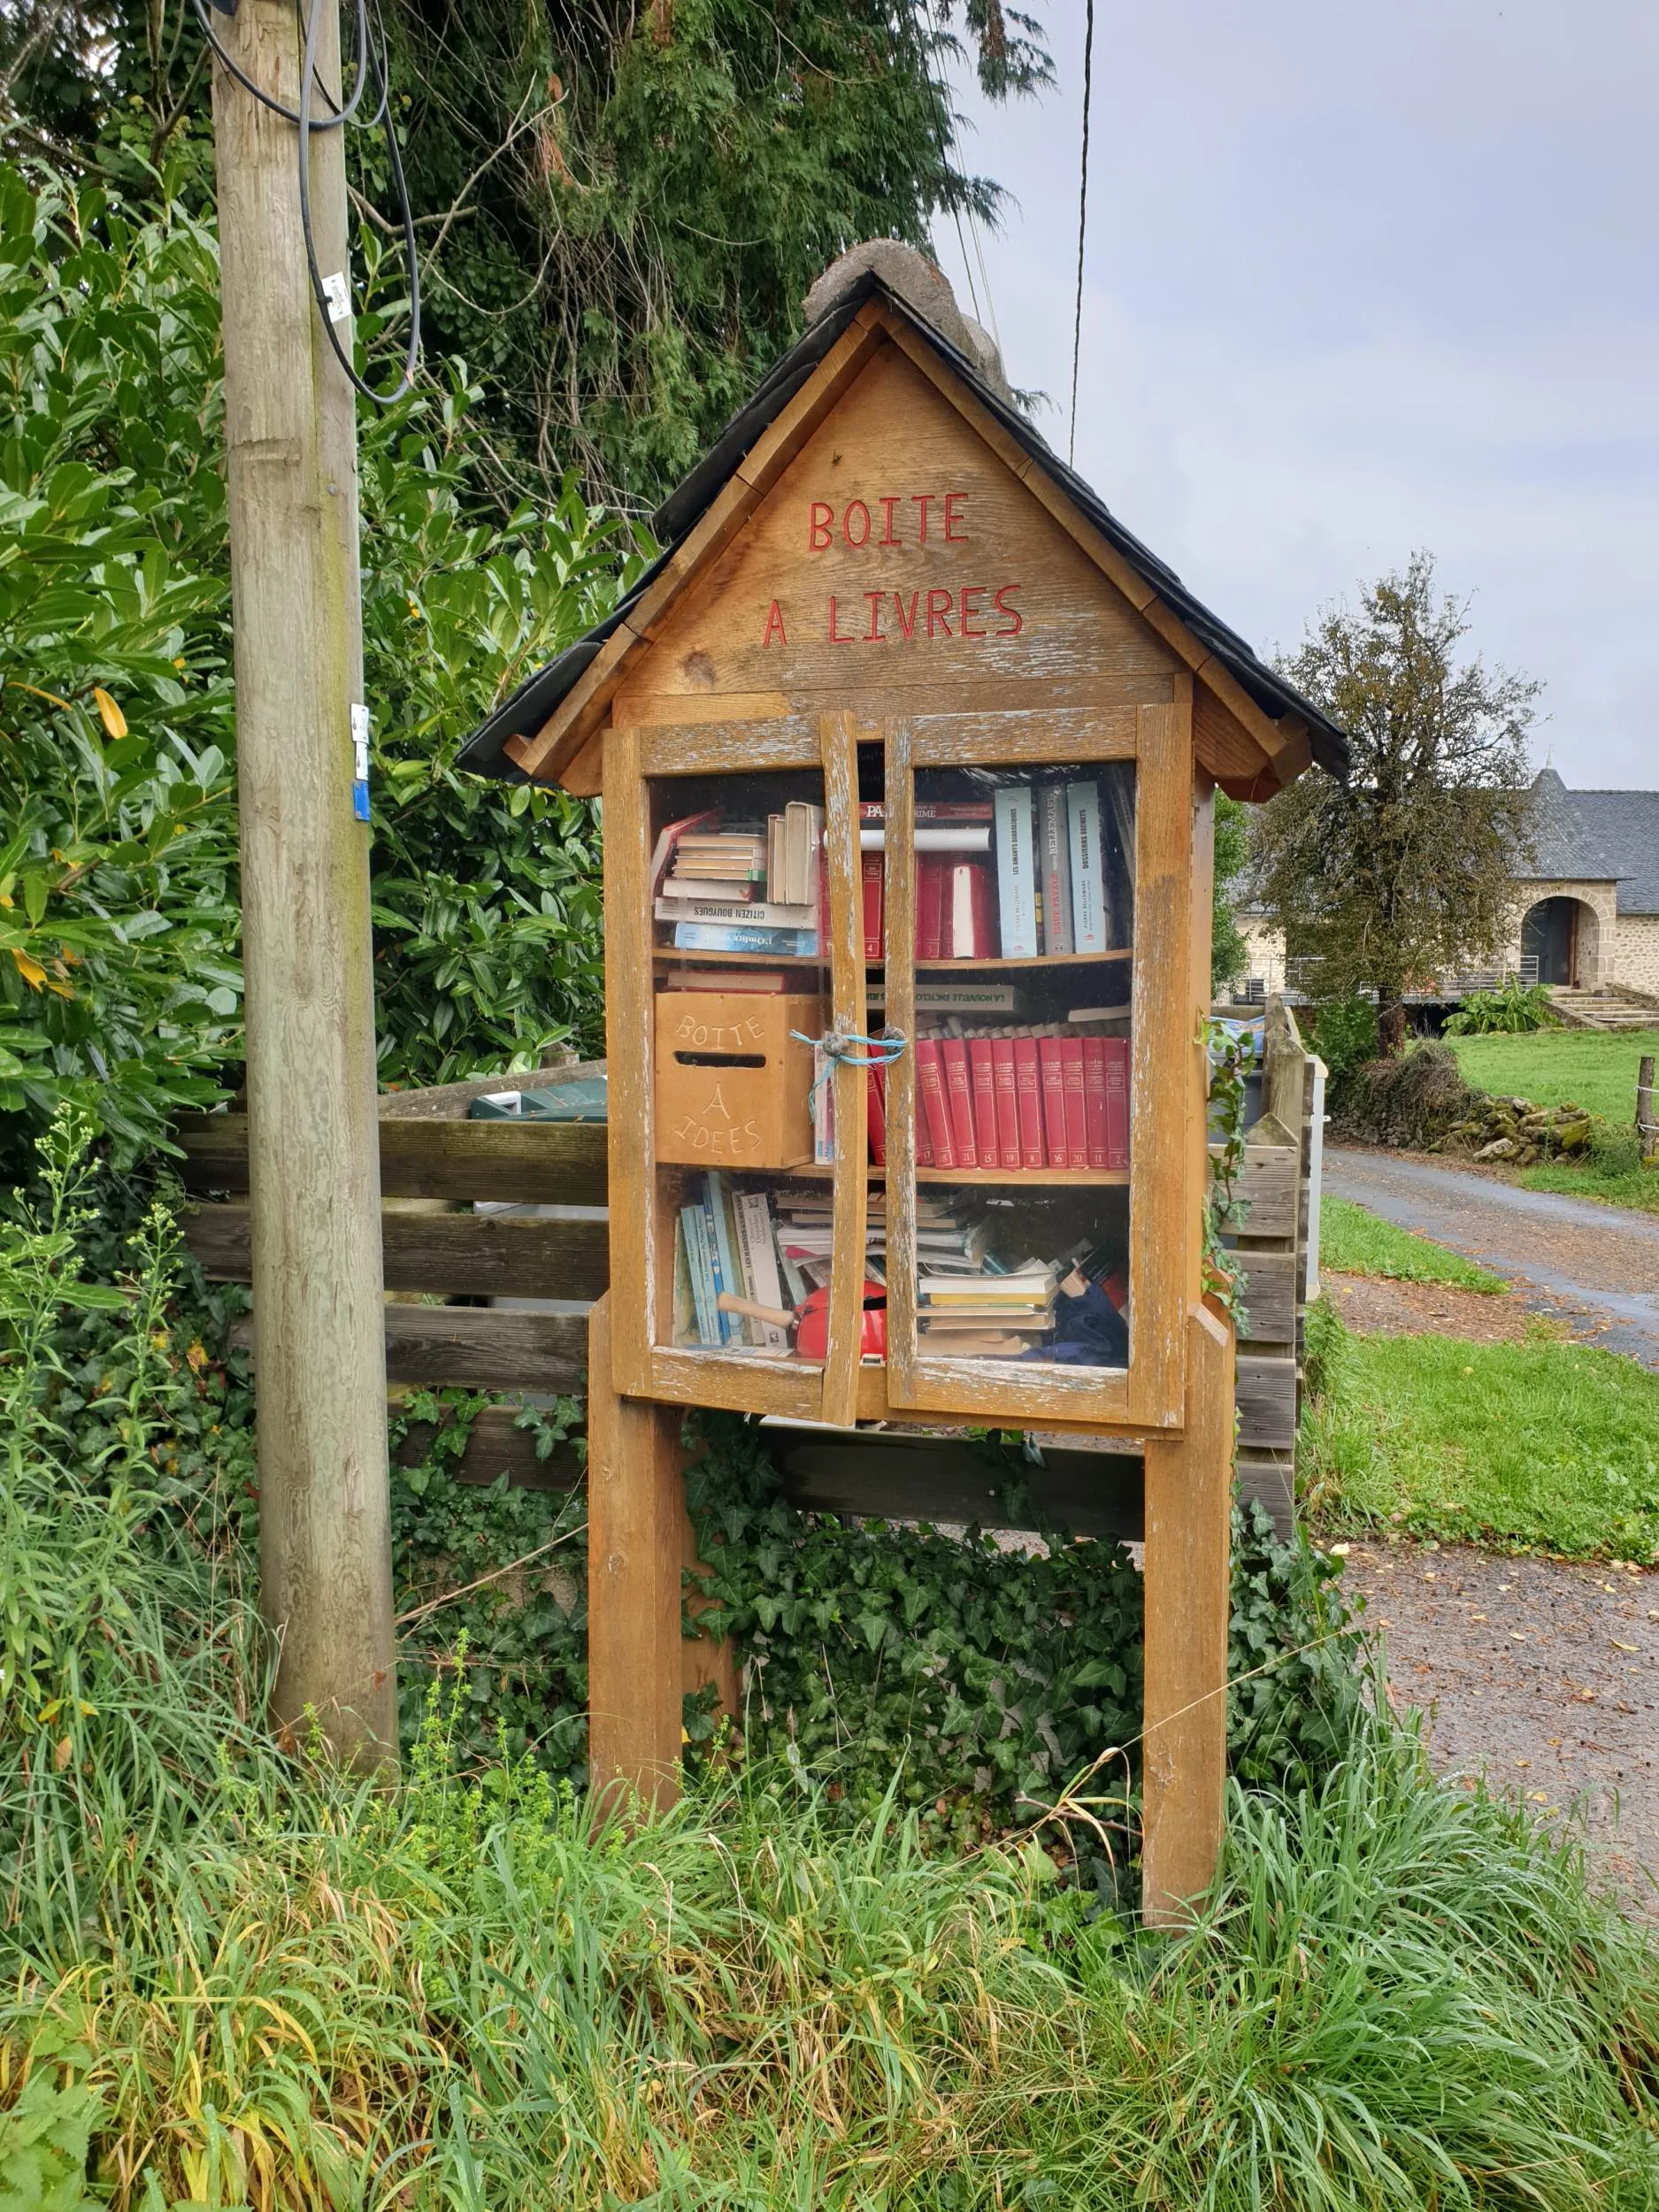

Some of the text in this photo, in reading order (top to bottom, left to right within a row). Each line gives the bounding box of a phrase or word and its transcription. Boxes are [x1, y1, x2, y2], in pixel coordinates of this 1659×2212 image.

[808, 493, 970, 552] BOITE
[763, 584, 1023, 648] A LIVRES
[866, 805, 885, 818] PA
[914, 810, 936, 818] RIME
[1048, 795, 1057, 855] BELLEMARE
[694, 906, 765, 919] CITIZEN BOUYGUES
[868, 944, 873, 953] 4
[916, 993, 949, 1002] ENCYCLO
[952, 994, 994, 1002] NOUVELLE
[676, 1015, 765, 1050] BOITE
[702, 1081, 731, 1119] A
[673, 1115, 763, 1154] IDEES
[985, 1154, 992, 1163] 15
[1029, 1154, 1035, 1163] 8
[1055, 1154, 1063, 1163] 16
[1073, 1154, 1082, 1163] 20
[1095, 1154, 1102, 1163] 11
